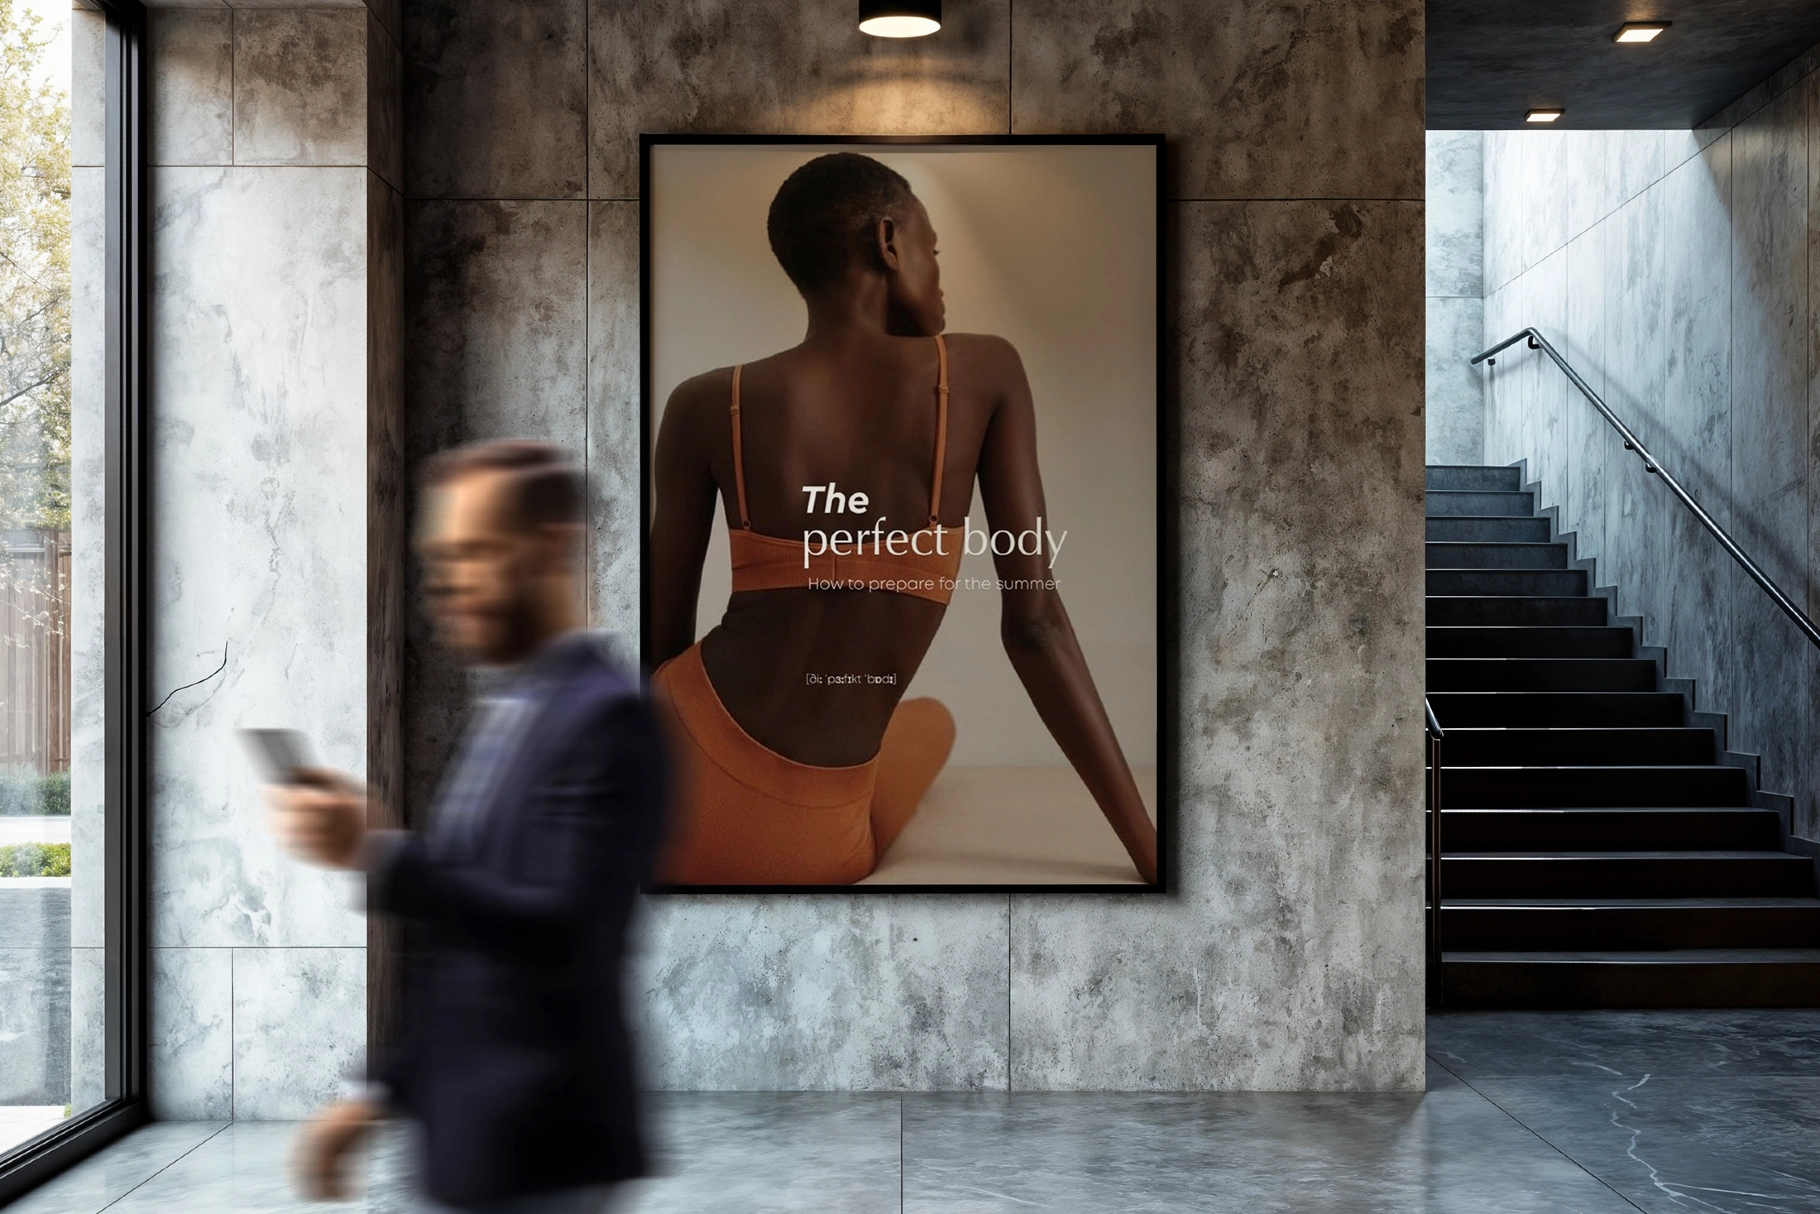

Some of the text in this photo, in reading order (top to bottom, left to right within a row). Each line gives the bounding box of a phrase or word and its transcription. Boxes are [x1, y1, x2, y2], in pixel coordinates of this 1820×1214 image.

[801, 482, 870, 514] The
[803, 516, 1068, 569] perfect body
[808, 576, 1062, 593] How to prepare for the summer
